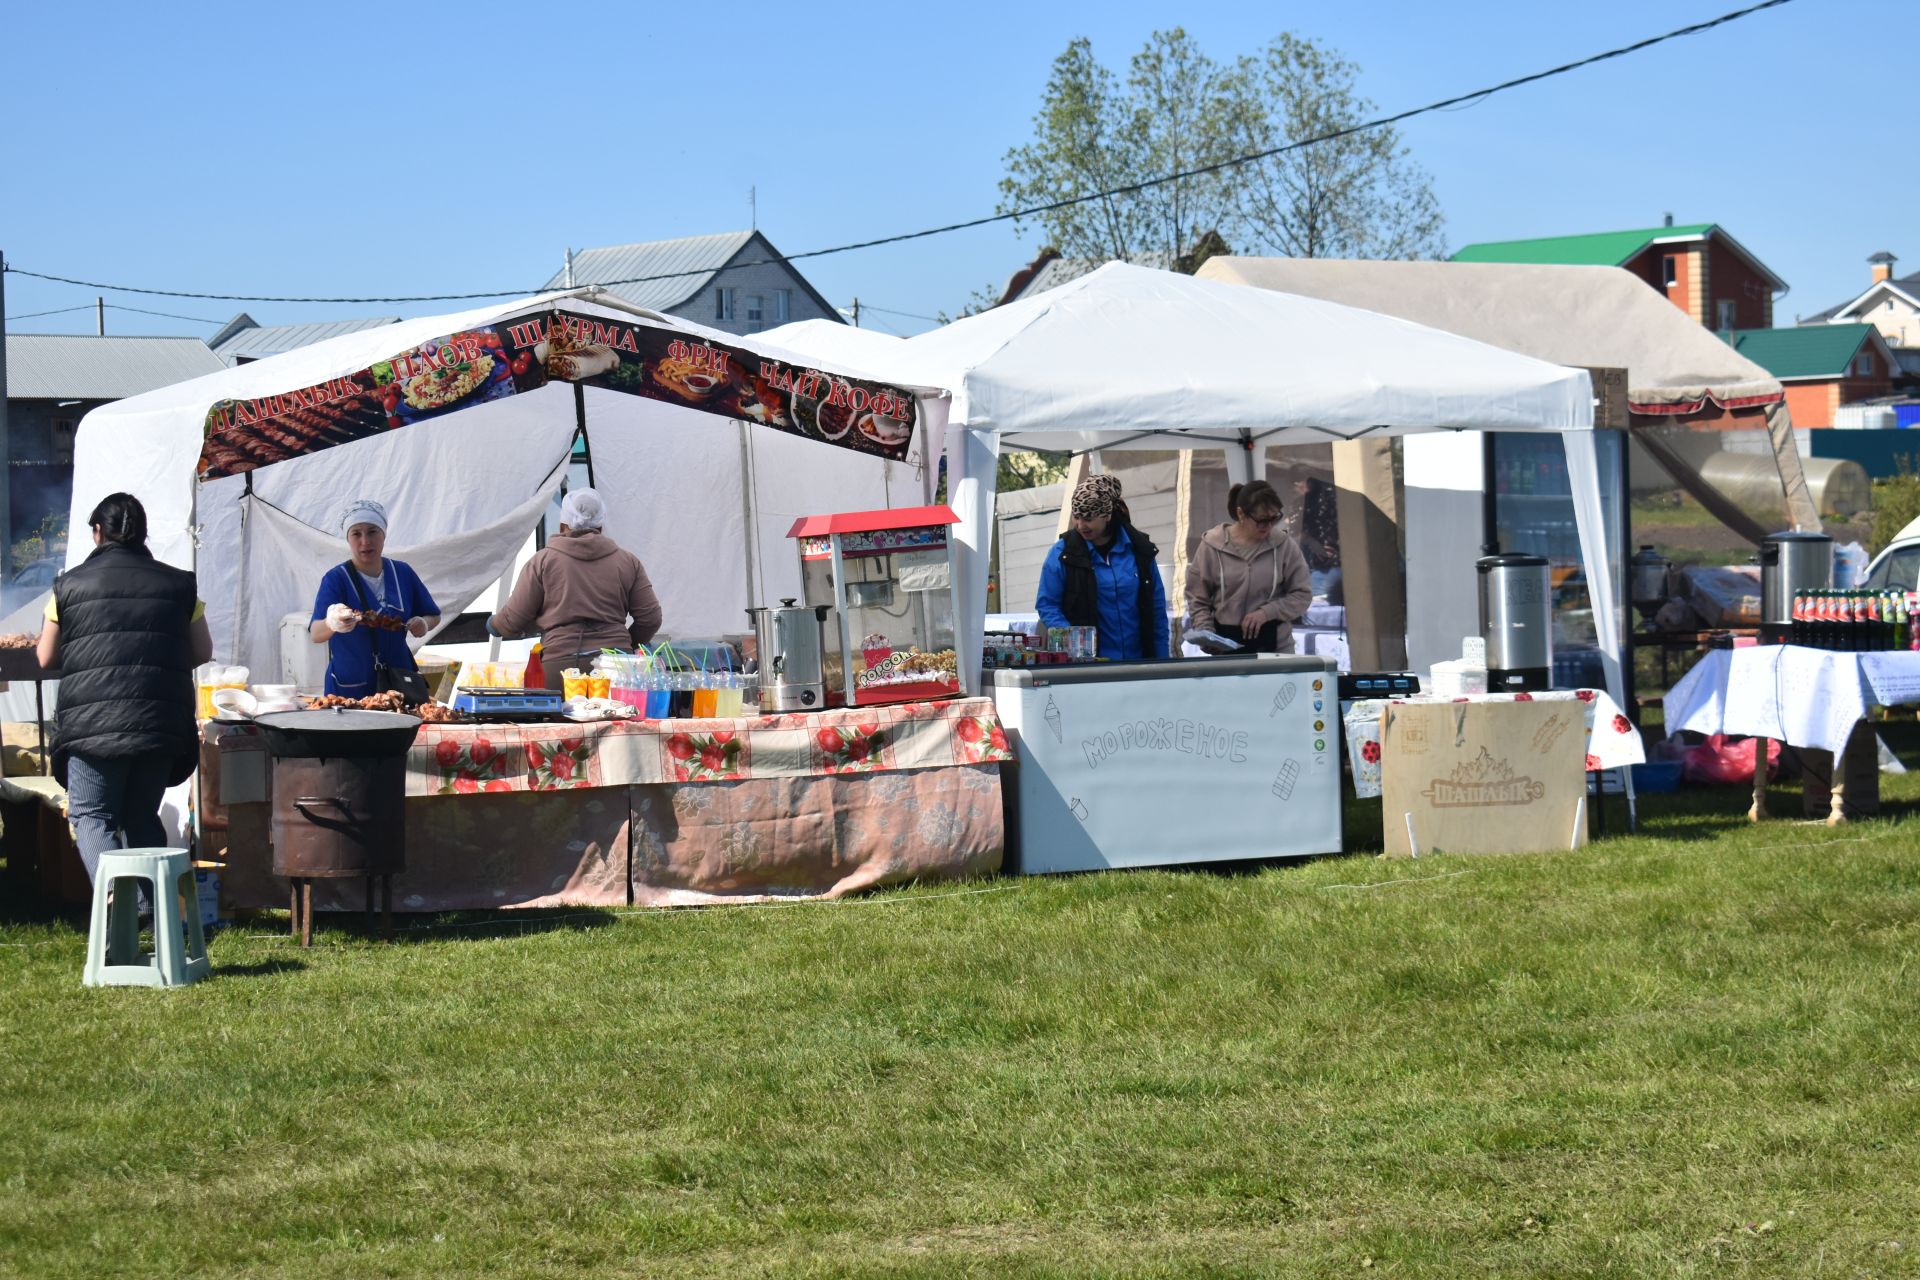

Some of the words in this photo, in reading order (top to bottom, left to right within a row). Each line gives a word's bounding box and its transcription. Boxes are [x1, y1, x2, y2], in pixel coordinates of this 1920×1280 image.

[389, 338, 482, 382] ПЛОВ
[507, 314, 640, 354] ШАУРМА
[667, 338, 731, 375] ФРИ
[760, 361, 821, 400] ЧАЙ
[827, 378, 909, 421] КОФЕ
[1081, 718, 1249, 769] МОРОЖЕНОЕ
[1434, 781, 1530, 803] ШАШЛЫК
